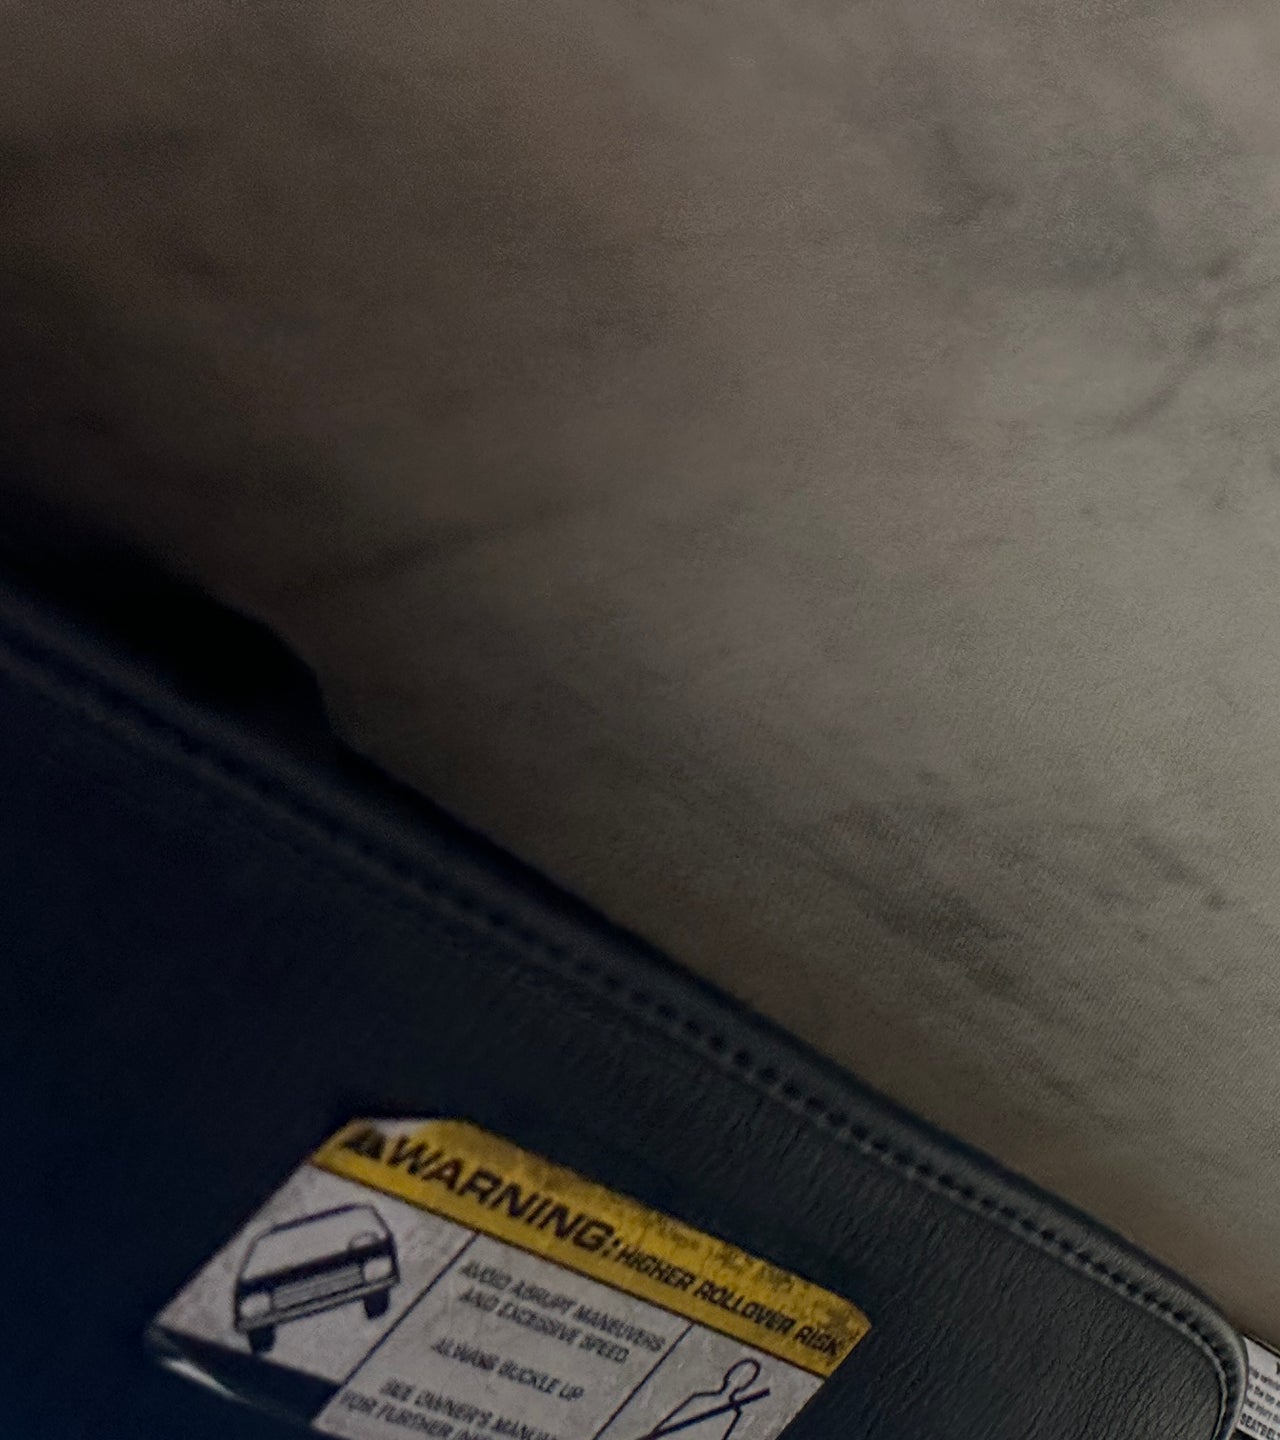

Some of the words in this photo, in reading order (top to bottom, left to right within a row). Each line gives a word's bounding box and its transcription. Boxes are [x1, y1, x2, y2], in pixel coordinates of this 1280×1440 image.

[387, 1134, 621, 1259] WARNING:
[614, 1244, 697, 1292] HIGHER
[693, 1279, 798, 1335] ROLLOVER
[794, 1324, 845, 1357] RISK
[458, 1286, 500, 1312] AND
[459, 1260, 512, 1290] AVOID
[573, 1304, 667, 1352] MANEUVERS
[430, 1336, 500, 1371] ALWAYS
[498, 1360, 560, 1395] BUCKLE
